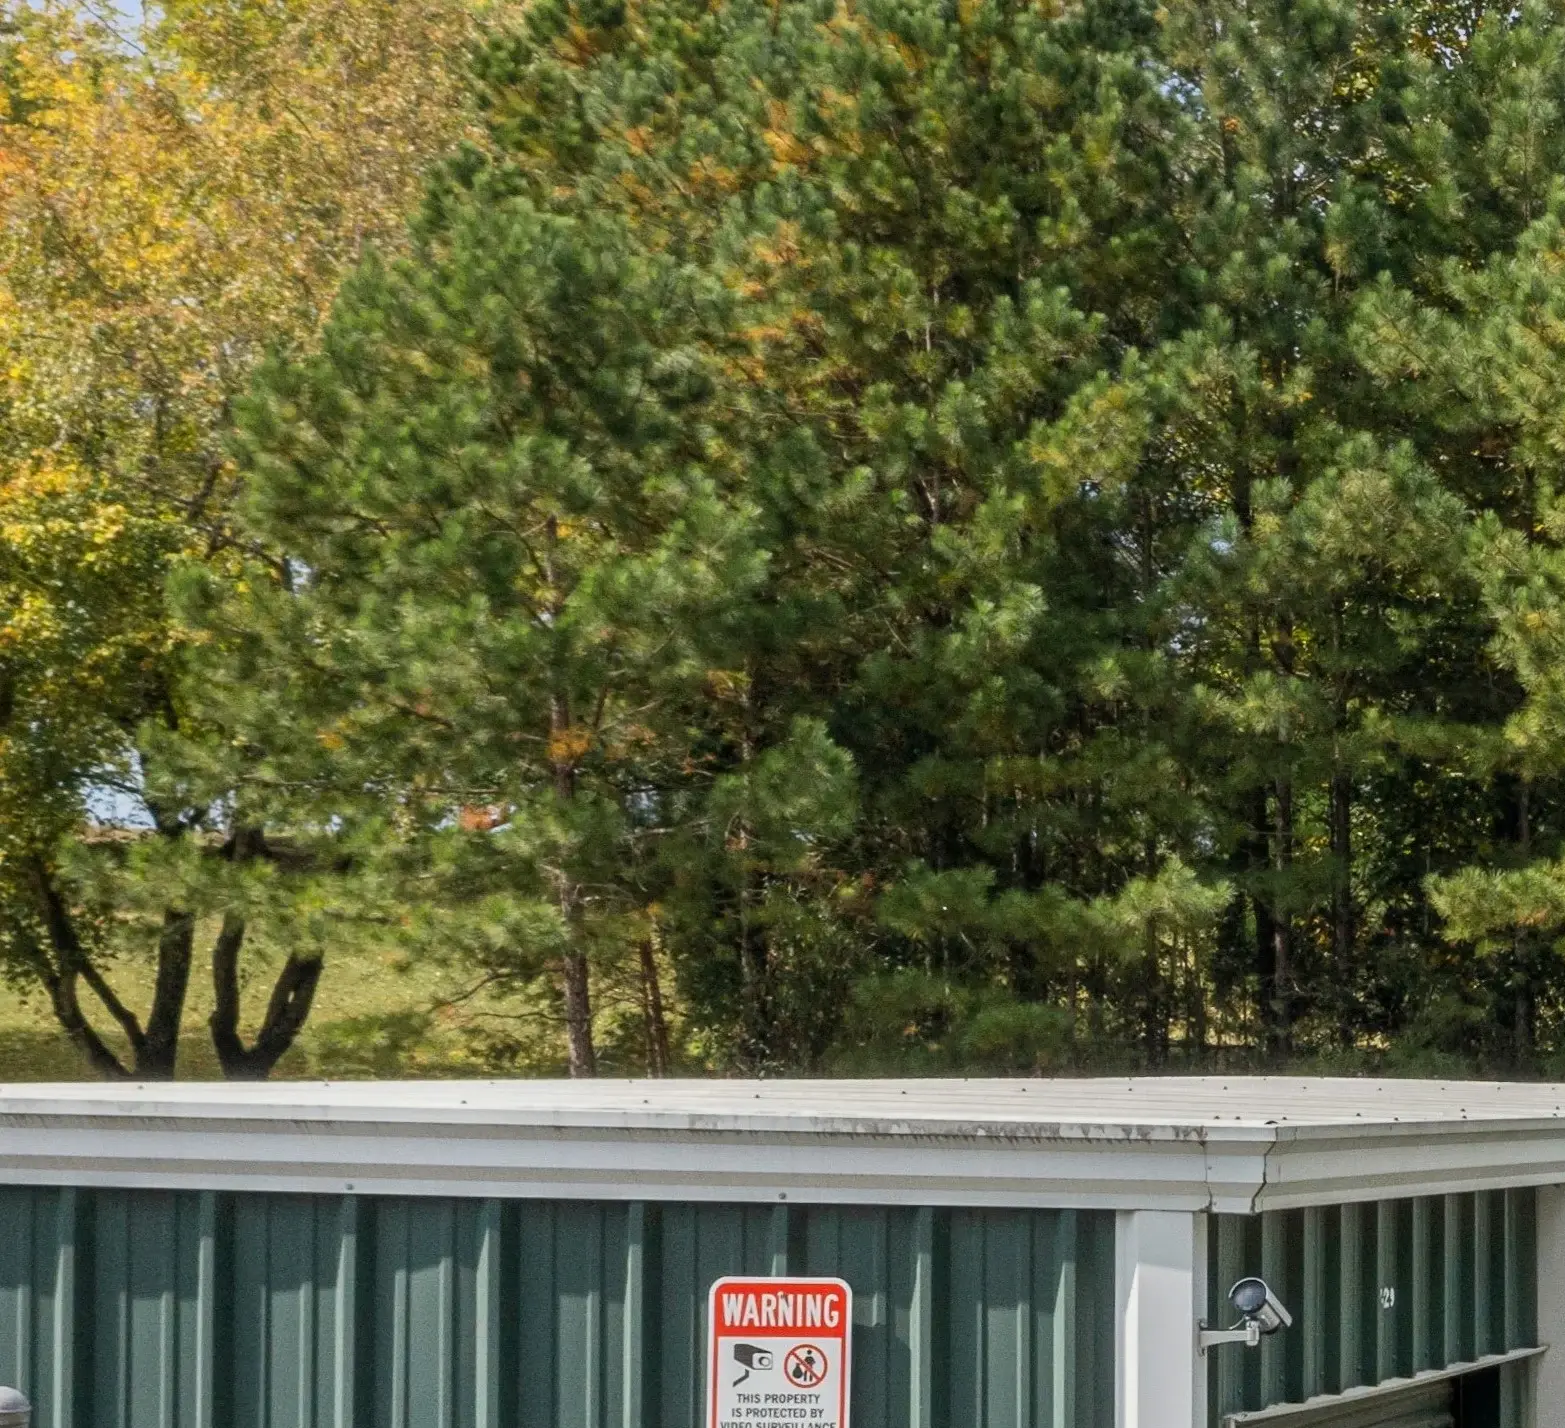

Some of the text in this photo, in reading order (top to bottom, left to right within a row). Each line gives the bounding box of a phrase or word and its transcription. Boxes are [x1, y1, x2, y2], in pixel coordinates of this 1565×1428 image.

[722, 1293, 839, 1328] WARNING
[737, 1394, 820, 1404] THIS PROPERTY
[732, 1408, 824, 1419] IS PROTECTED BY
